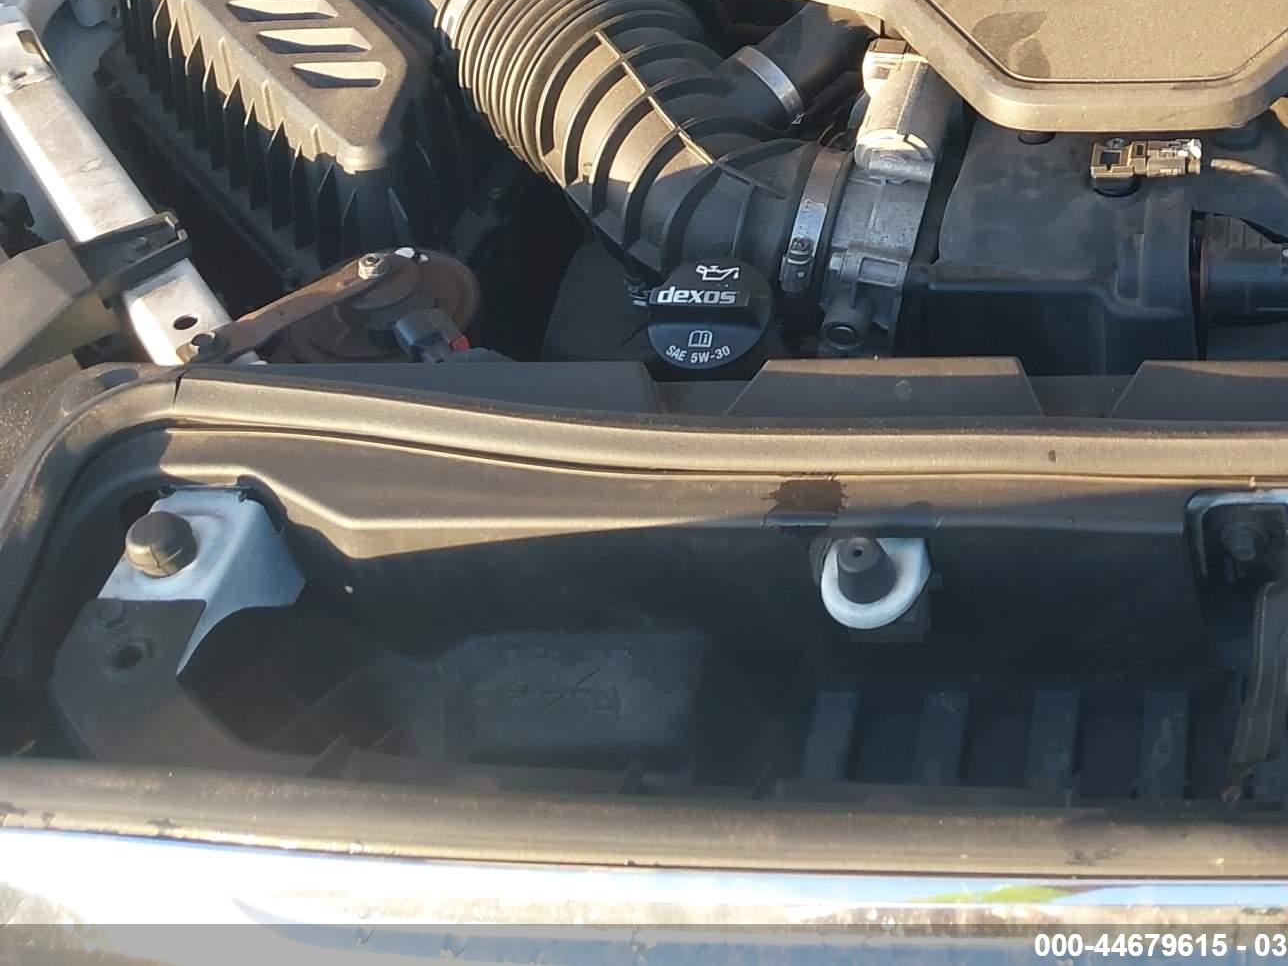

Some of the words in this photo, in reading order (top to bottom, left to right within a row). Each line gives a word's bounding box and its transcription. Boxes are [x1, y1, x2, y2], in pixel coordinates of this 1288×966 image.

[657, 285, 737, 304] dexos
[666, 345, 687, 362] SAE
[690, 345, 731, 364] 5W-30
